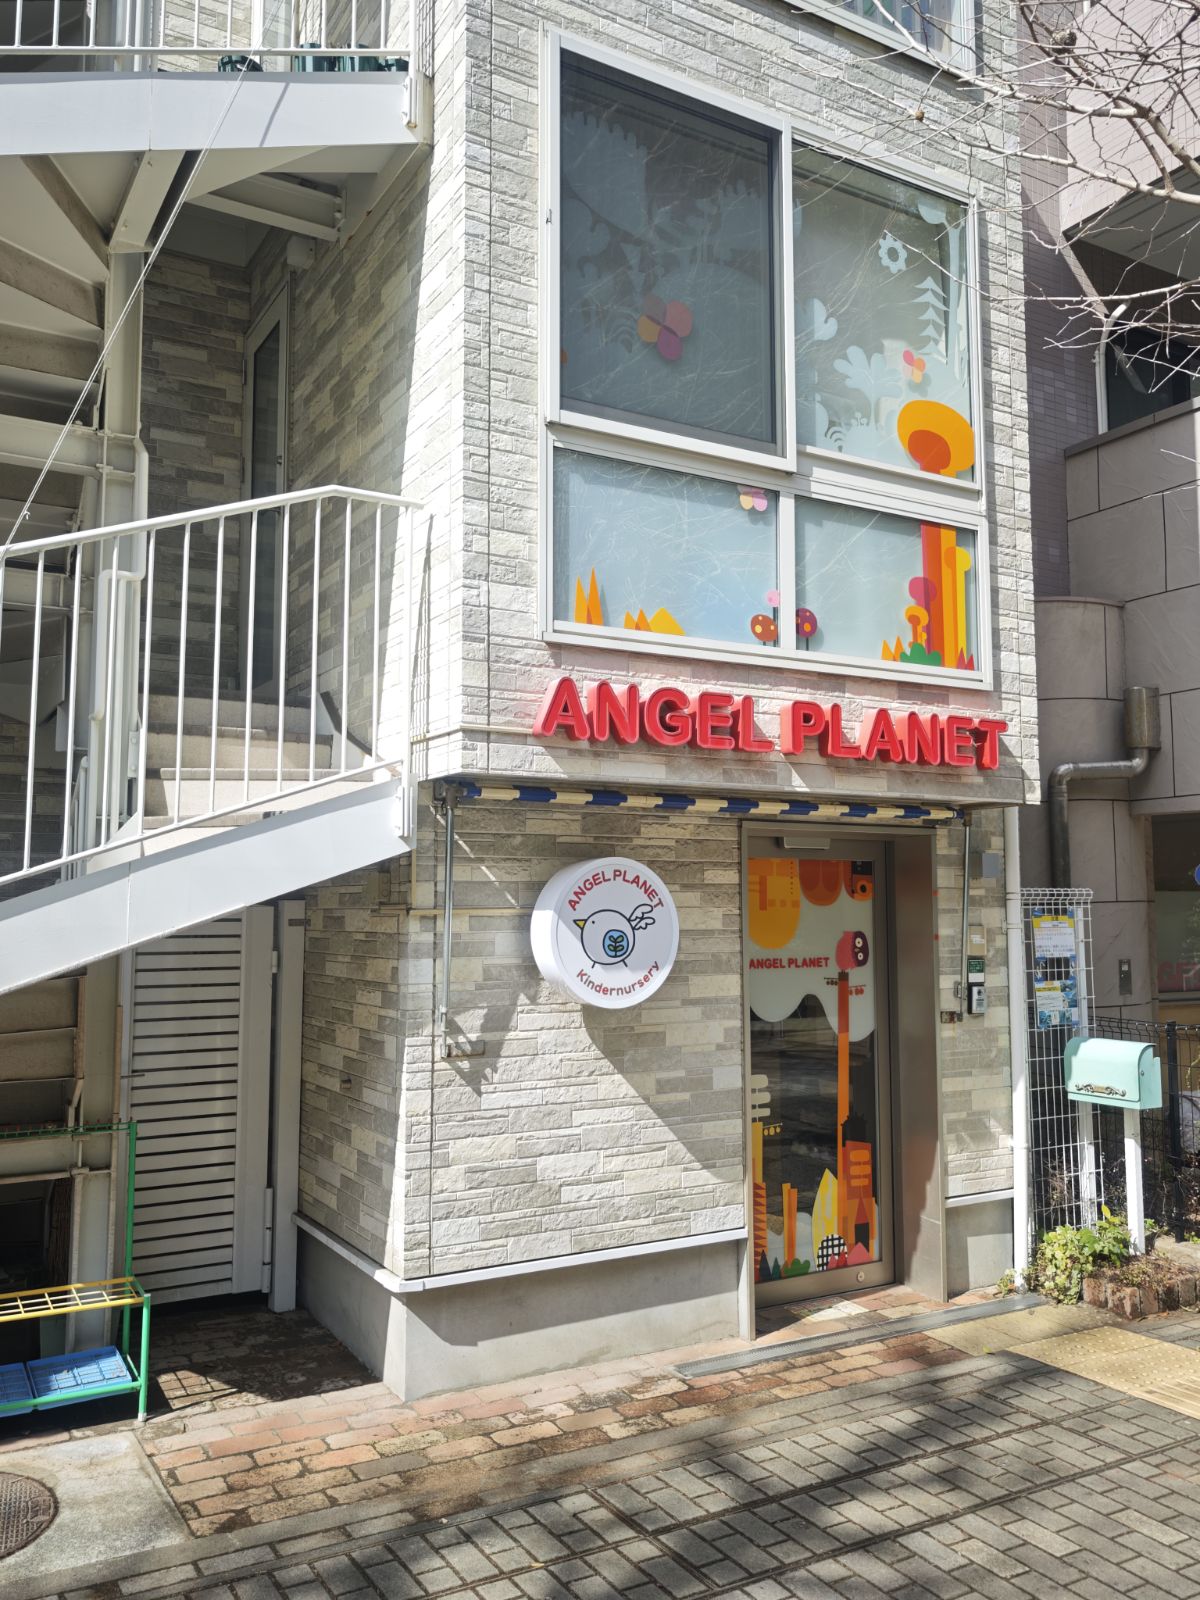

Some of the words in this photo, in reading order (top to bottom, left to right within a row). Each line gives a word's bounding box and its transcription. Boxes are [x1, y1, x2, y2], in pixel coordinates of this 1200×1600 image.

[536, 676, 775, 752] ANGEL
[782, 700, 1009, 770] PLANET
[568, 870, 612, 912] ANGEL
[613, 868, 665, 910] PLANET
[576, 960, 661, 997] Kindernursery
[748, 957, 786, 970] ANGEL
[787, 956, 830, 969] PLANET
